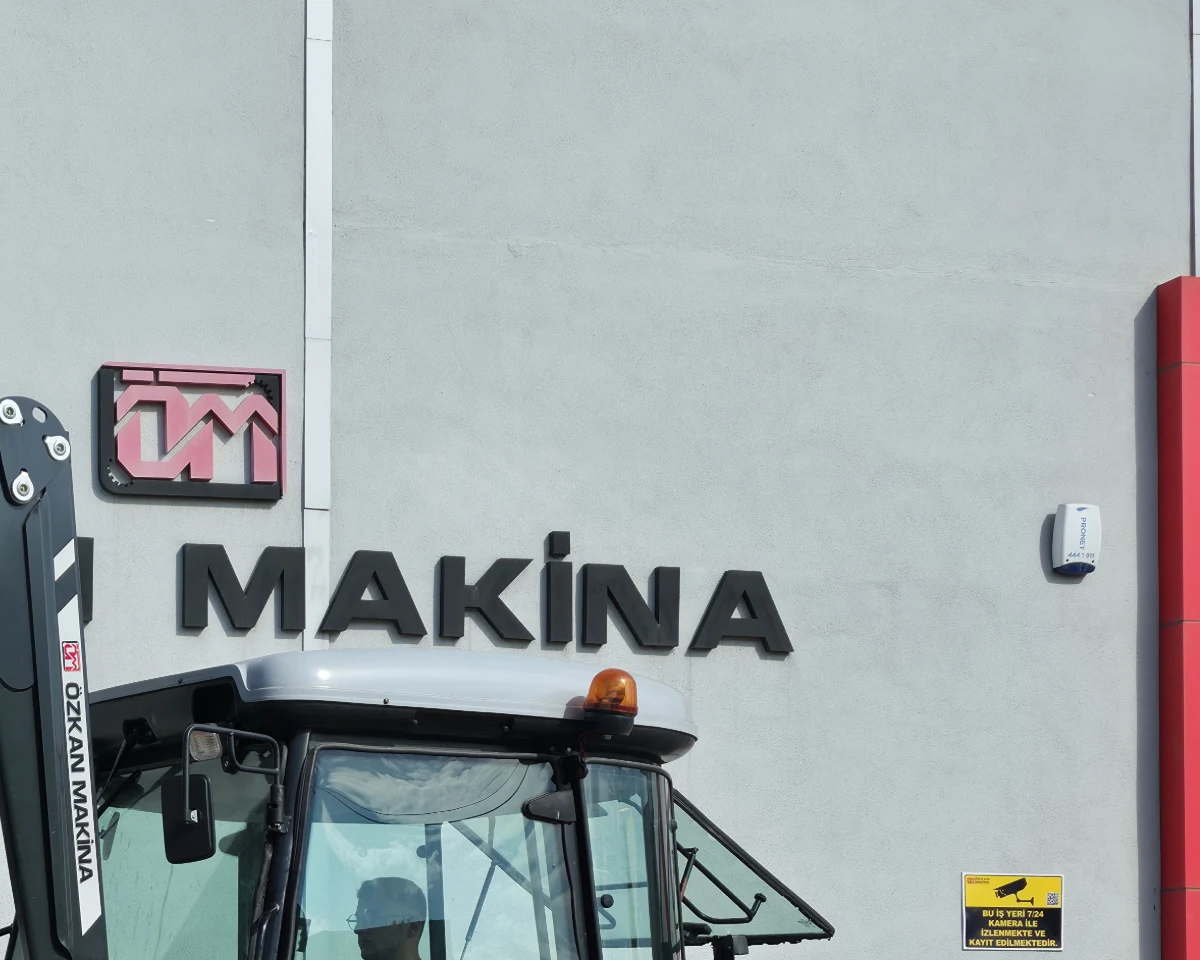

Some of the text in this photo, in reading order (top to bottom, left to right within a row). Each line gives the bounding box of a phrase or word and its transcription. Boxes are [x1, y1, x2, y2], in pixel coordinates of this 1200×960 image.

[1079, 517, 1087, 550] PRONET
[181, 531, 795, 655] MAKİNA
[65, 682, 94, 885] ÖZKAN MAKİNA
[982, 909, 1044, 918] BU İŞ YERİ 7/24
[988, 919, 1038, 927] KAMERA İLE
[981, 928, 1033, 937] İZLENMEKTE
[996, 938, 1058, 947] EDİLMEKTEDİR.
